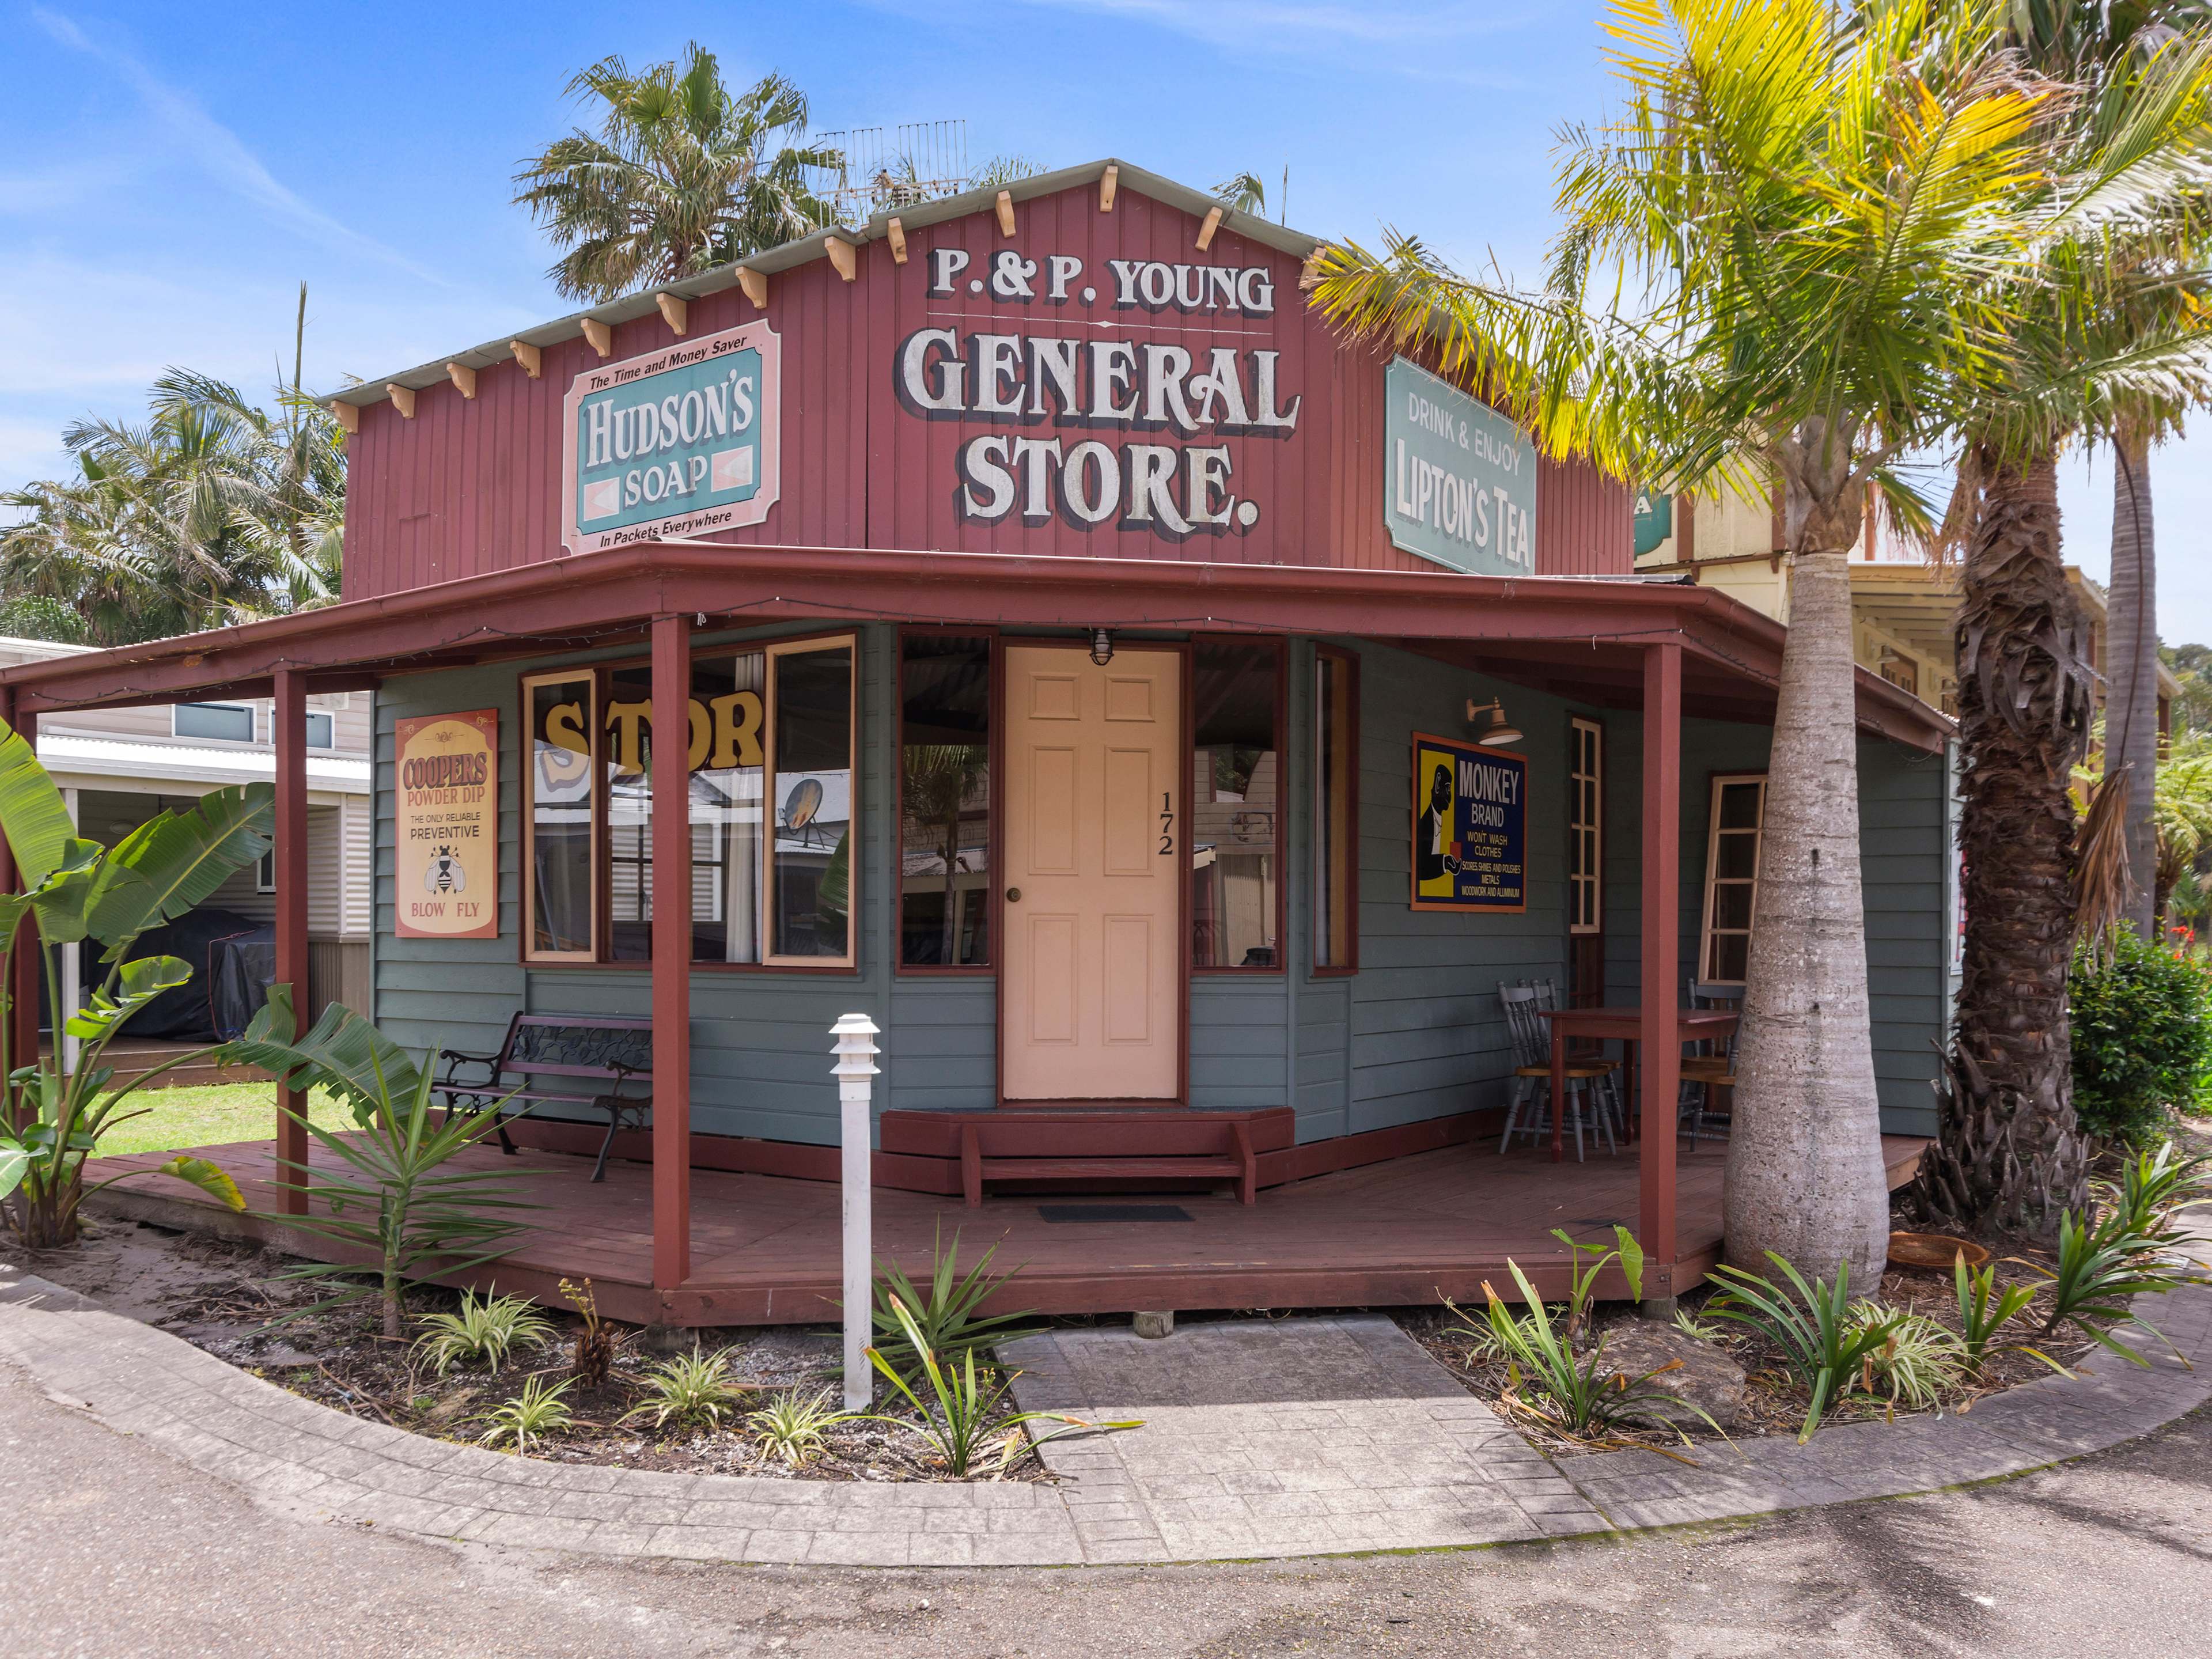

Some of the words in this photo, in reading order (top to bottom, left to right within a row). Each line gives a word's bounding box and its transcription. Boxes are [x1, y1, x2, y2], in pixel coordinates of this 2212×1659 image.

[993, 251, 1036, 296] &
[1110, 260, 1274, 312] YOUNG
[590, 377, 609, 390] The
[614, 368, 641, 383] Time
[645, 357, 666, 374] and
[669, 347, 707, 368] Money
[712, 336, 747, 354] Saver
[903, 328, 1301, 430] GENERAL
[586, 369, 753, 467] HUDSON'S
[1408, 392, 1455, 442] DRINK
[1459, 421, 1469, 450] &
[1475, 428, 1521, 476] ENJOY
[624, 455, 707, 507] SOAP
[964, 435, 1258, 533] STORE.
[1396, 438, 1488, 547] LIPTON'S
[1494, 486, 1529, 567] TEA
[600, 535, 611, 547] In
[613, 525, 658, 545] Packets
[662, 512, 732, 535] Everywhere
[403, 752, 488, 790] COOPERS
[1459, 760, 1519, 805] MONKEY
[407, 788, 458, 806] POWDER
[463, 786, 485, 804] DIP
[411, 814, 423, 824] THE
[426, 814, 444, 823] ONLY
[446, 812, 480, 822] RELIABLE
[411, 825, 479, 840] PREVENTIVE
[1158, 792, 1173, 855] 172
[1471, 803, 1504, 827] BRAND
[1467, 830, 1487, 843] WON'T
[1489, 834, 1508, 846] WASH
[1475, 846, 1502, 858] CLOTHES
[1482, 874, 1500, 885] METALS
[1493, 863, 1502, 873] AND
[1502, 864, 1521, 874] POLISHES
[1461, 885, 1487, 896] WOODWORK
[1487, 887, 1497, 897] AND
[412, 903, 445, 917] BLOW
[457, 902, 479, 917] FLY
